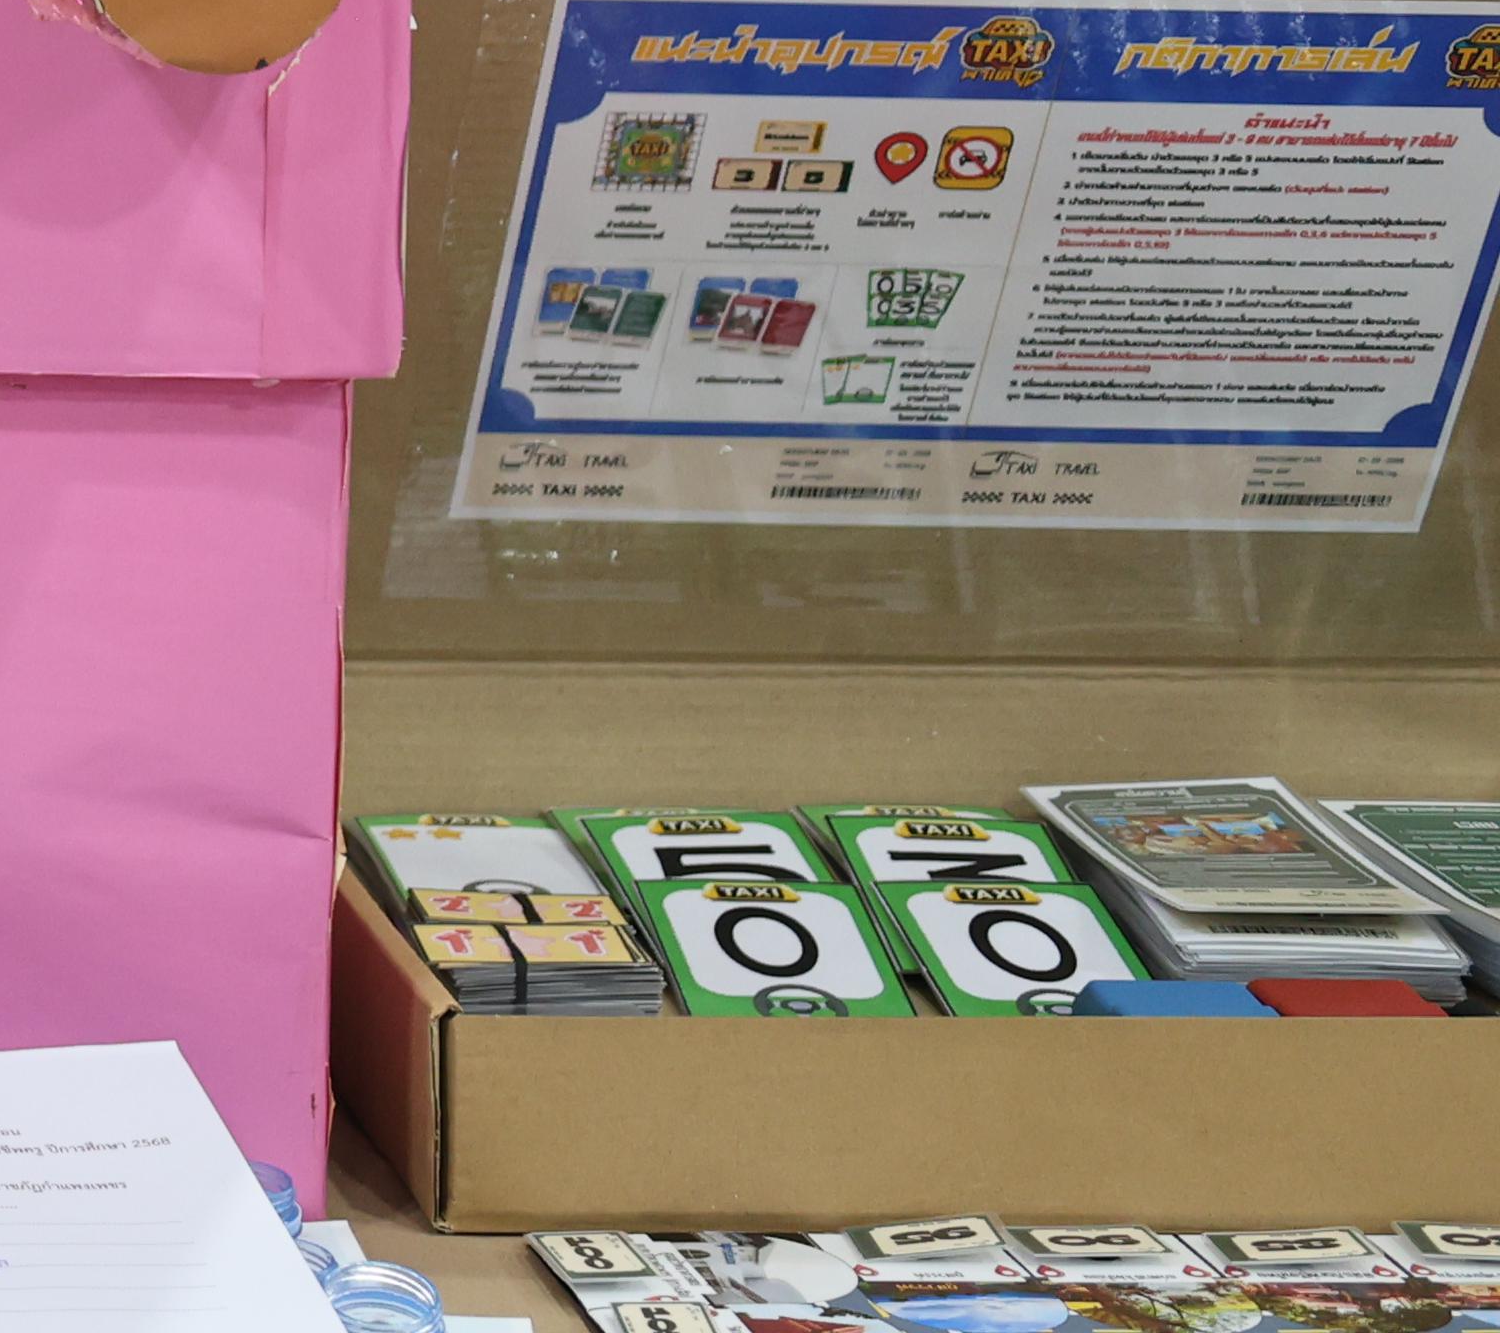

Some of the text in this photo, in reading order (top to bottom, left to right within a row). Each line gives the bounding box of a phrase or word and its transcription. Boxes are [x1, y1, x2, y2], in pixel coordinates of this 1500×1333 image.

[631, 24, 968, 75] แนะนำอุปกรณ์
[972, 39, 1049, 63] TAXI
[1112, 24, 1420, 77] กติกาการเล่น
[1244, 112, 1331, 130] คำแนะนำ
[542, 483, 578, 497] TAXI
[1010, 491, 1047, 505] TAXI
[662, 819, 725, 832] TAXI
[910, 822, 971, 837] TAXI
[718, 885, 780, 899] TAXI
[960, 887, 1022, 901] TAXI
[132, 1136, 172, 1149] 2568
[563, 1235, 614, 1270] 100
